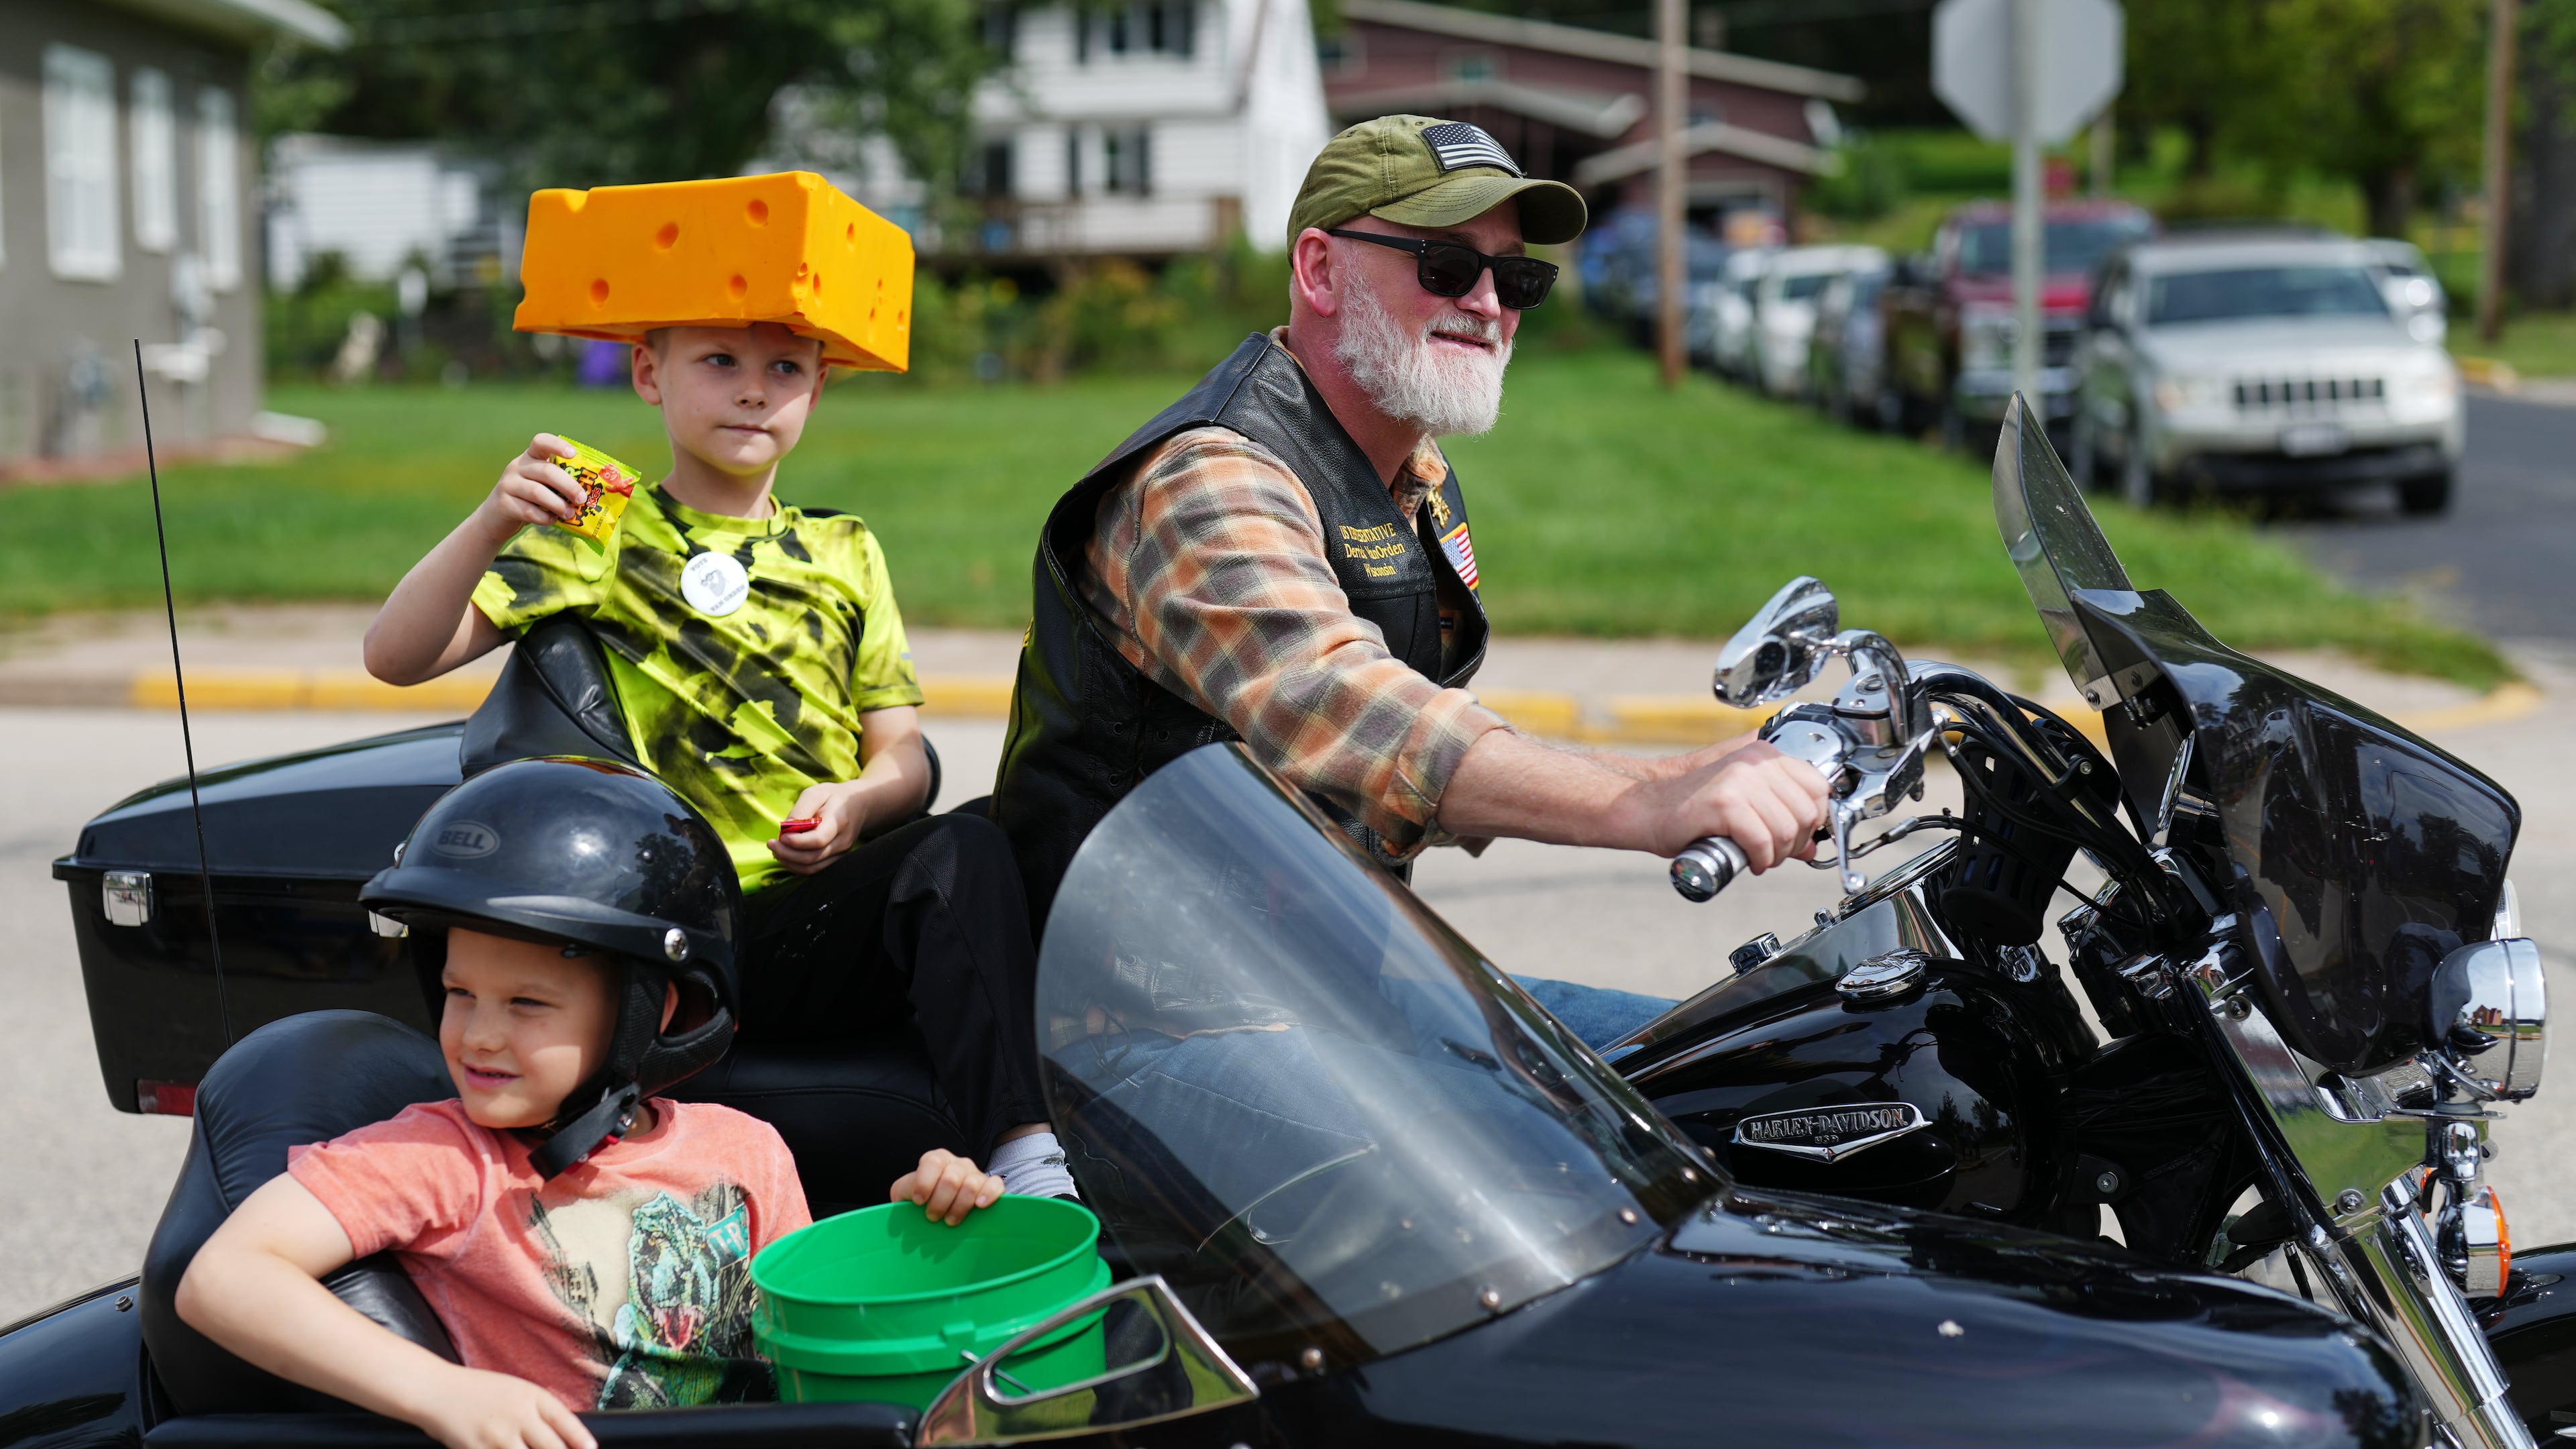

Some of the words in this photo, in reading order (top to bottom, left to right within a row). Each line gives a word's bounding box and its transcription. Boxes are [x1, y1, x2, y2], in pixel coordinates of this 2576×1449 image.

[564, 467, 598, 527] PACH
[586, 486, 602, 508] Kids
[1346, 523, 1397, 543] RESENTATIVE
[691, 557, 708, 571] VOTE
[1363, 563, 1397, 578] Wisconsin
[710, 598, 724, 612] VAN
[724, 584, 745, 602] ORDEN
[438, 830, 484, 850] BELL
[1750, 1107, 1909, 1140] HARLEY-DAVIDSON
